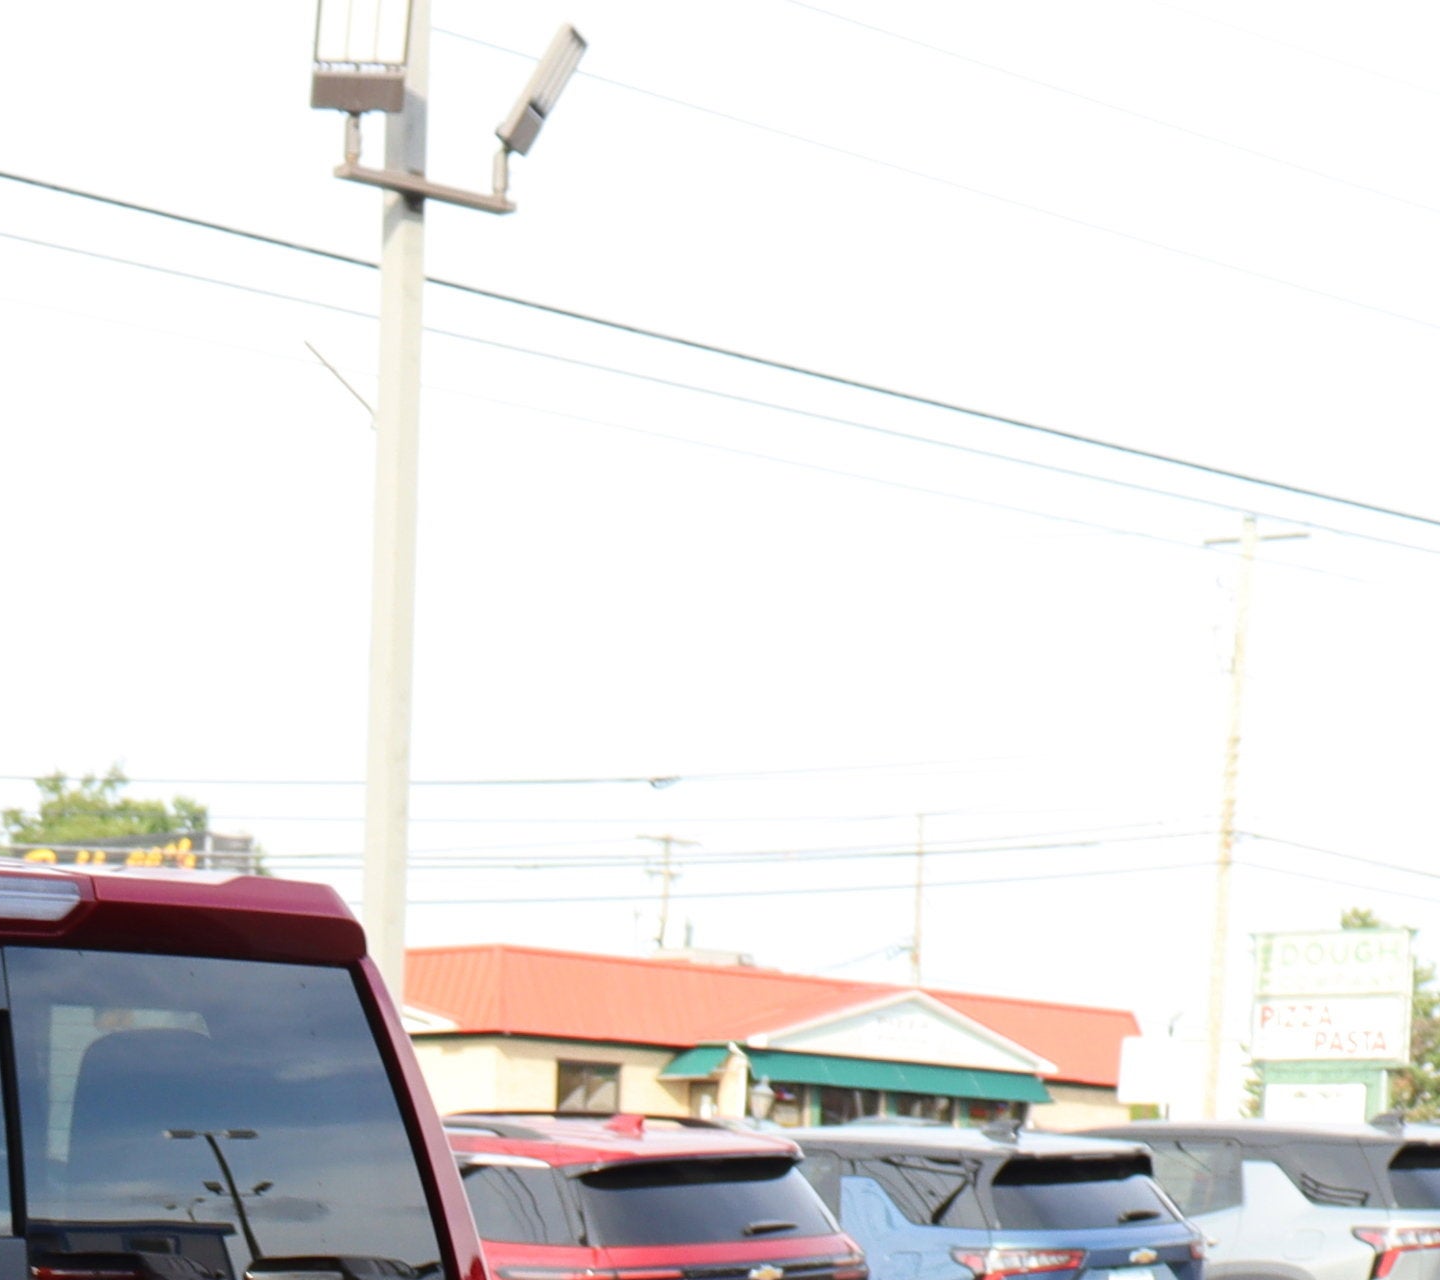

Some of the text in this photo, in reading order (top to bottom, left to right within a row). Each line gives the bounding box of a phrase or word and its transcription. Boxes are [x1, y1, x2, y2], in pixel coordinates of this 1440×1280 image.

[1280, 941, 1402, 967] DOUGH
[1260, 1005, 1331, 1028] PIZZA
[1314, 1031, 1387, 1054] PASTA
